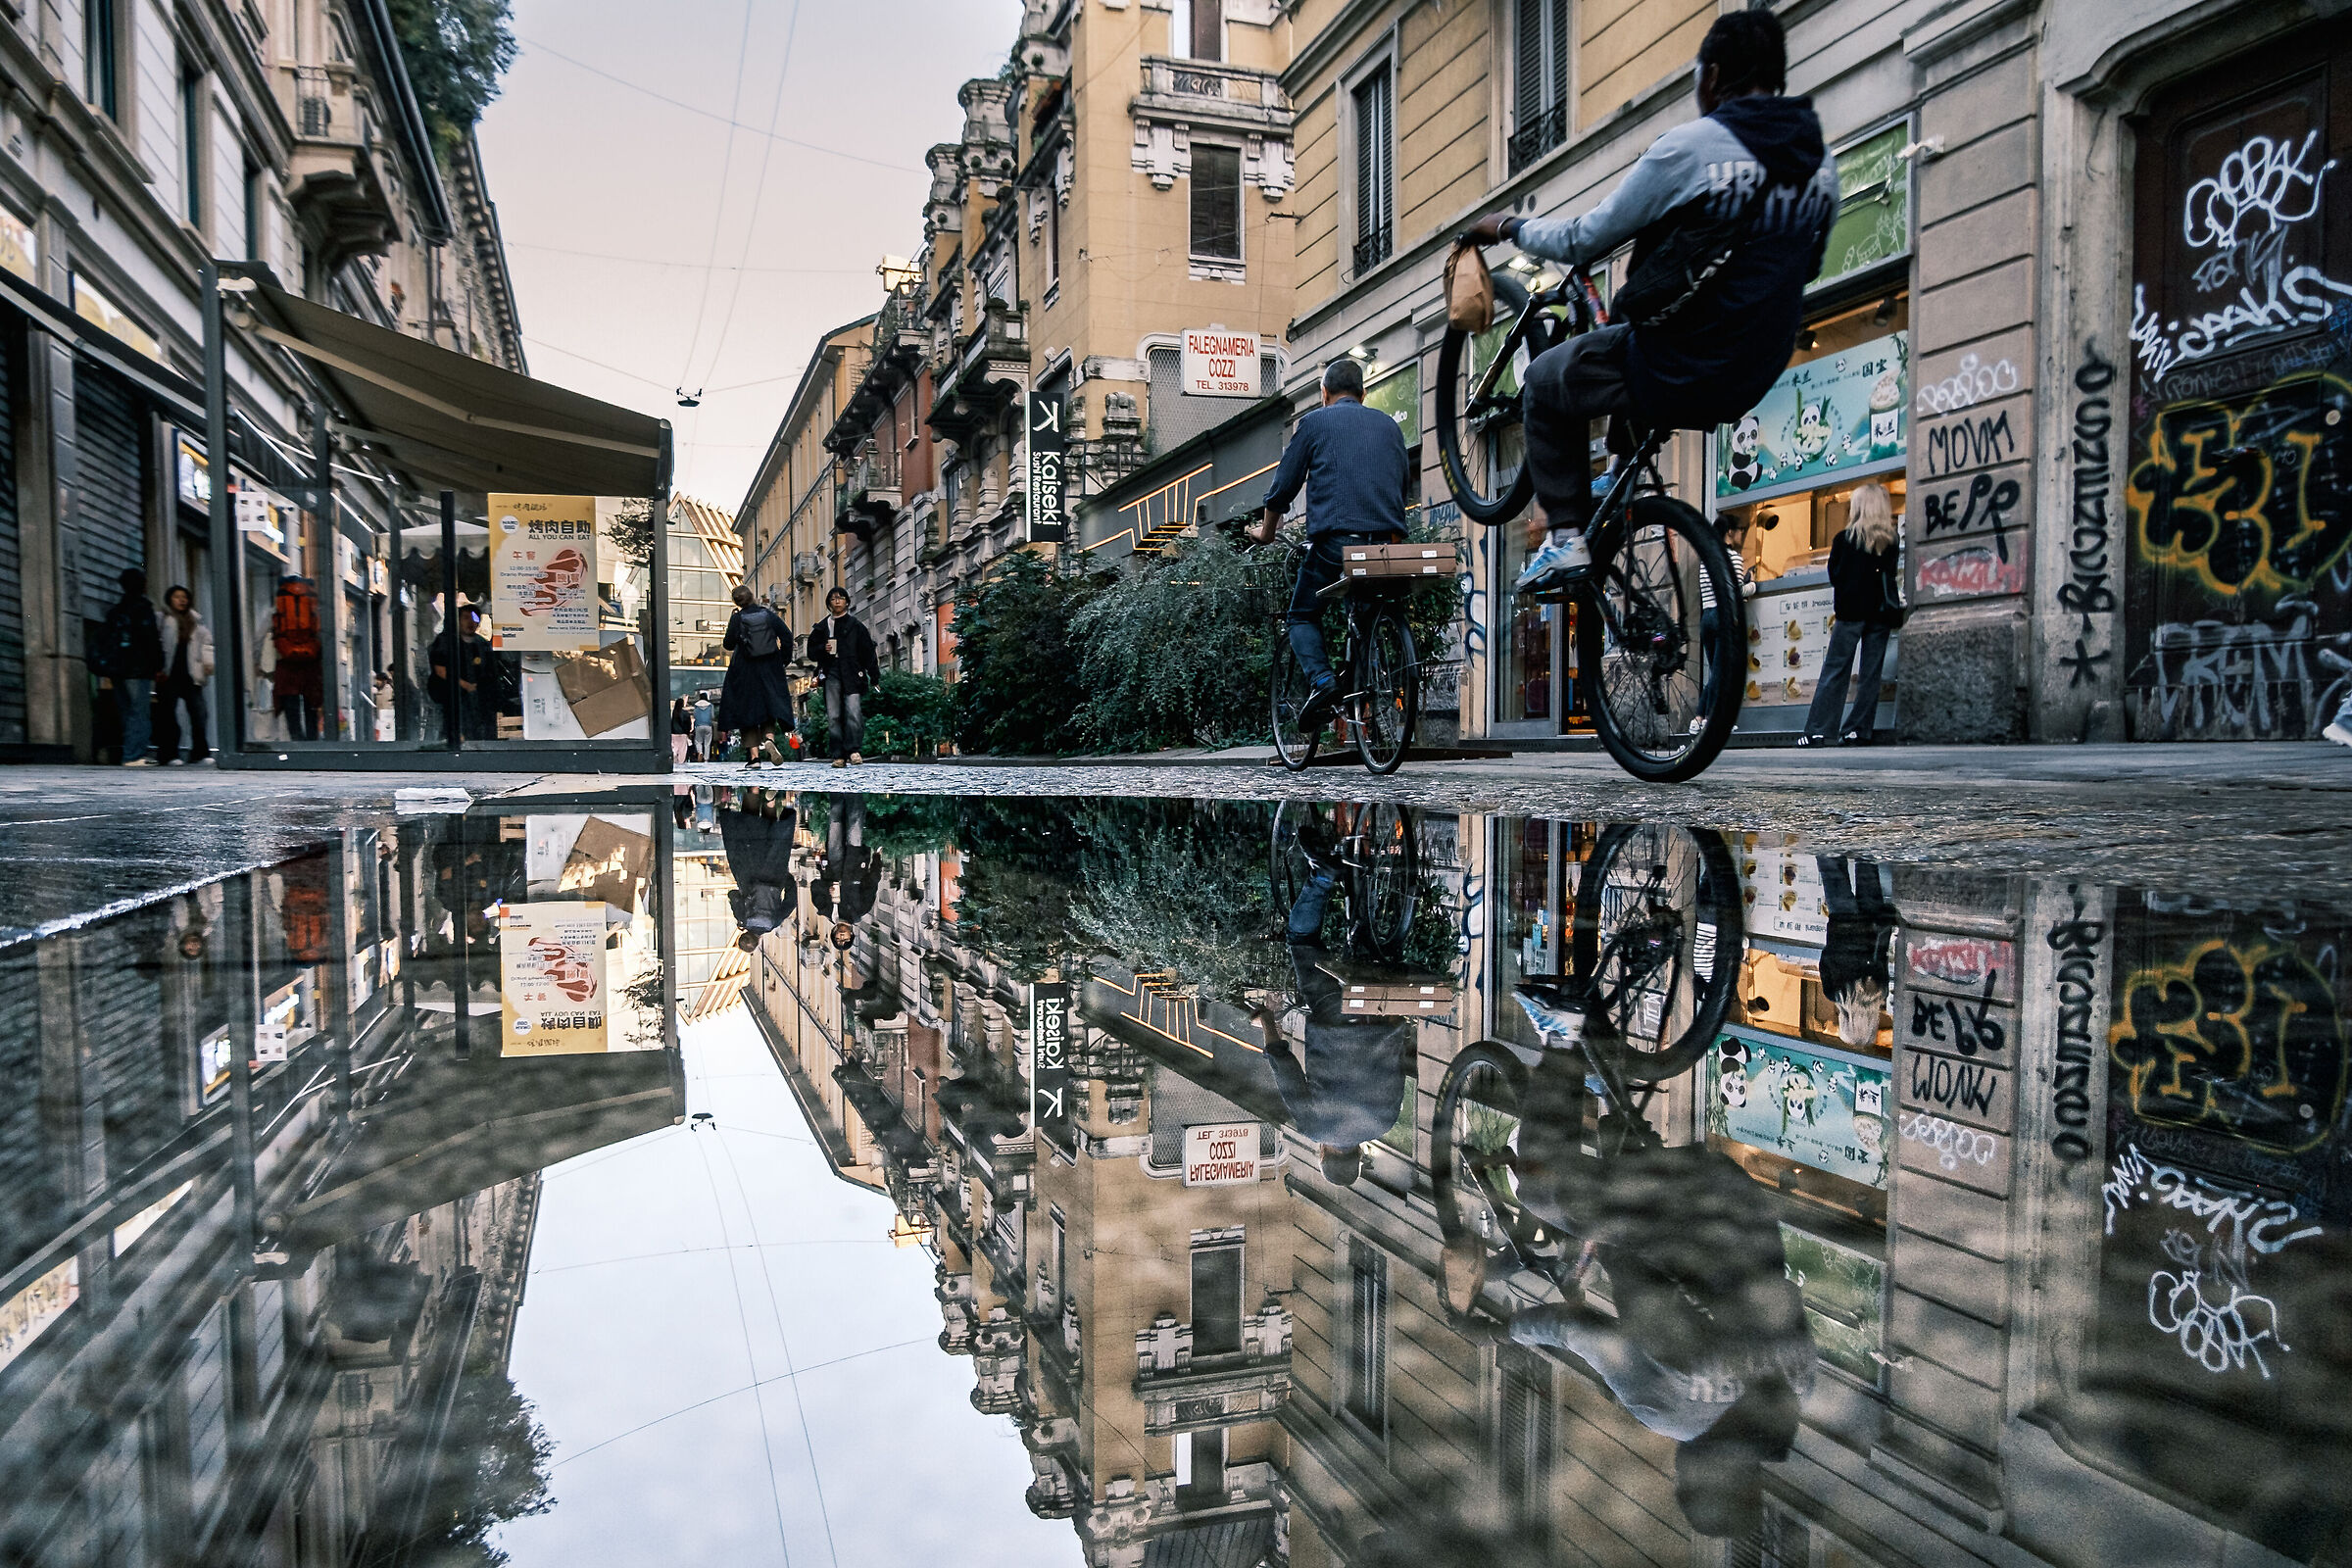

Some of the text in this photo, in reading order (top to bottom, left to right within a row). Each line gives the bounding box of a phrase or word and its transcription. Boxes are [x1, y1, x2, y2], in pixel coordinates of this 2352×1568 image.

[1189, 334, 1255, 357] FALEGNAMERIA
[1208, 359, 1236, 377] COZZI
[1196, 380, 1249, 392] TEL. 313978
[1042, 451, 1061, 525] Kaiseki
[528, 519, 591, 534] 烤肉自助
